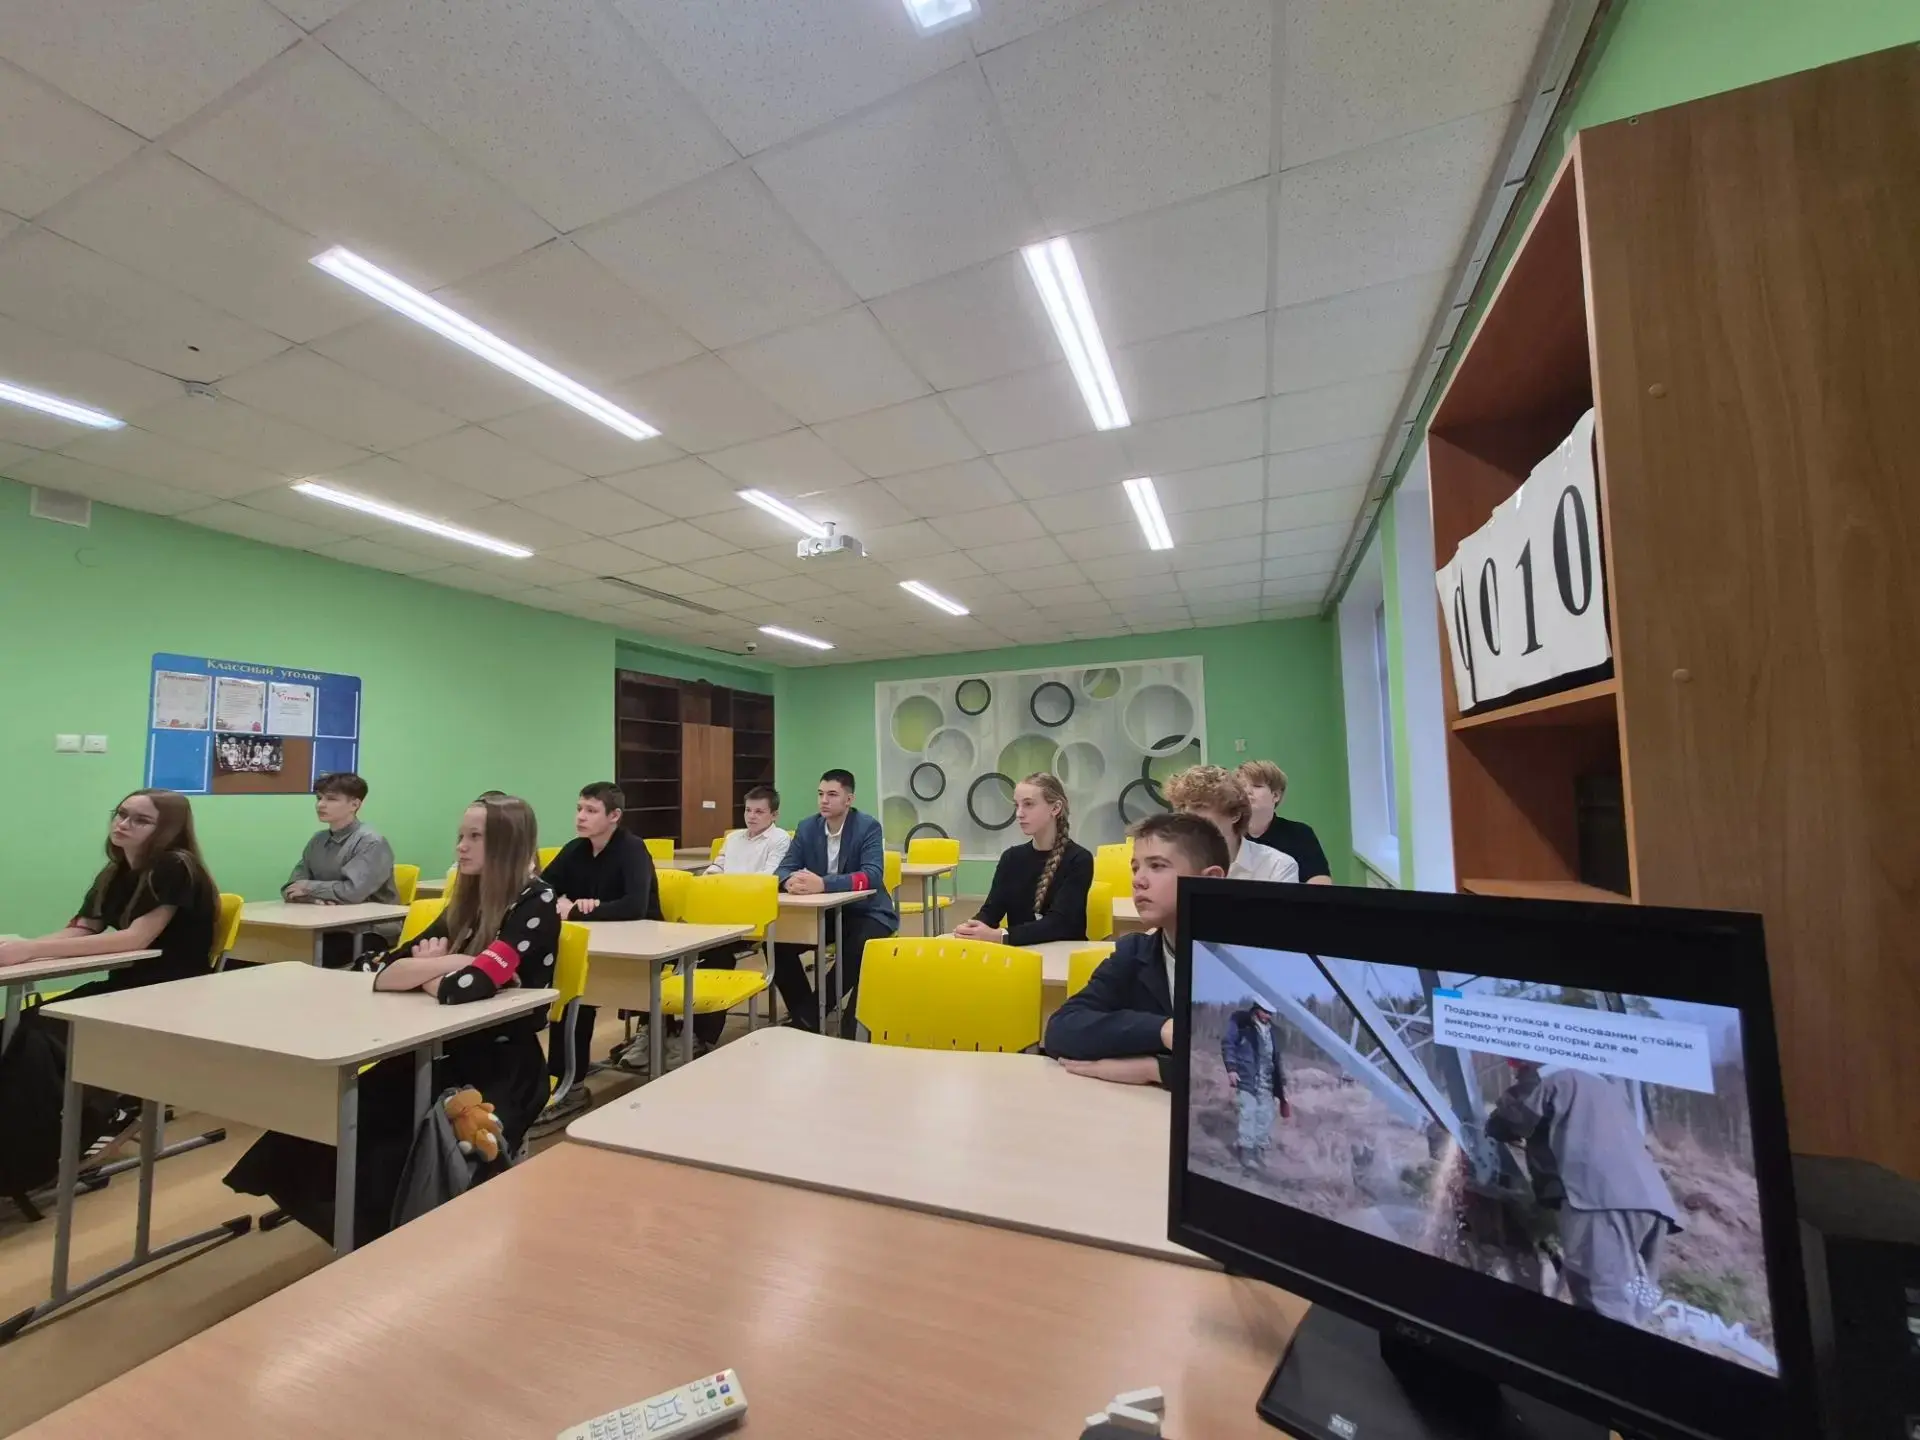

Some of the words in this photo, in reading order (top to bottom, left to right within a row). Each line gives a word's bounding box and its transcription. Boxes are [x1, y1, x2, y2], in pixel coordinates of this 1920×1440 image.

[207, 659, 274, 675] Классный
[280, 669, 322, 680] уголок
[1443, 1003, 1498, 1020] Подрезка
[1502, 1014, 1549, 1028] уголков
[1553, 1021, 1561, 1029] в
[1564, 1023, 1637, 1041] основании
[1641, 1035, 1693, 1050] стойки
[1444, 1029, 1530, 1050] последующего
[1547, 1033, 1590, 1047] опоры
[1593, 1041, 1618, 1052] для
[1621, 1045, 1639, 1055] ее
